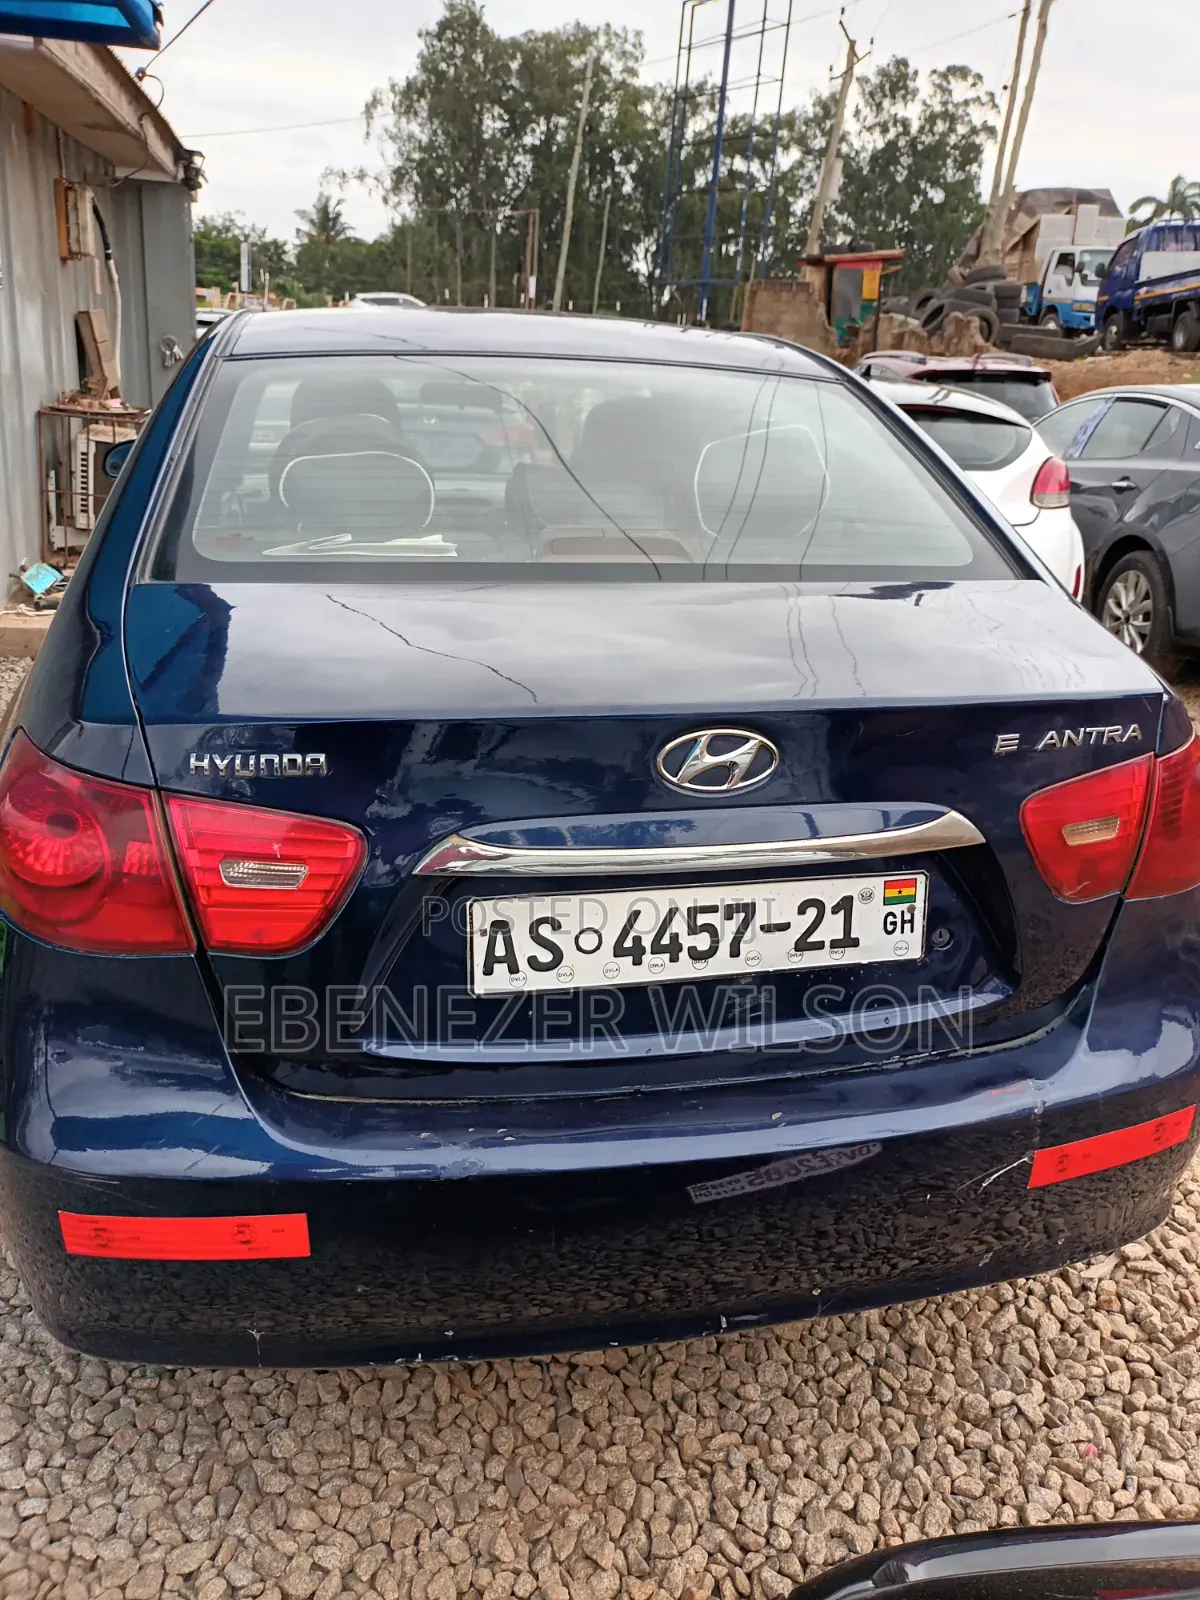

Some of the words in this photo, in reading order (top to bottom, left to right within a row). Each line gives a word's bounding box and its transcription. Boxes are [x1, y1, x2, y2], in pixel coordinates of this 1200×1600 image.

[1036, 724, 1143, 752] ANTRA
[189, 753, 328, 777] HYUNDA
[483, 916, 564, 976] AS
[613, 895, 860, 966] 4457-21
[883, 910, 915, 935] GH
